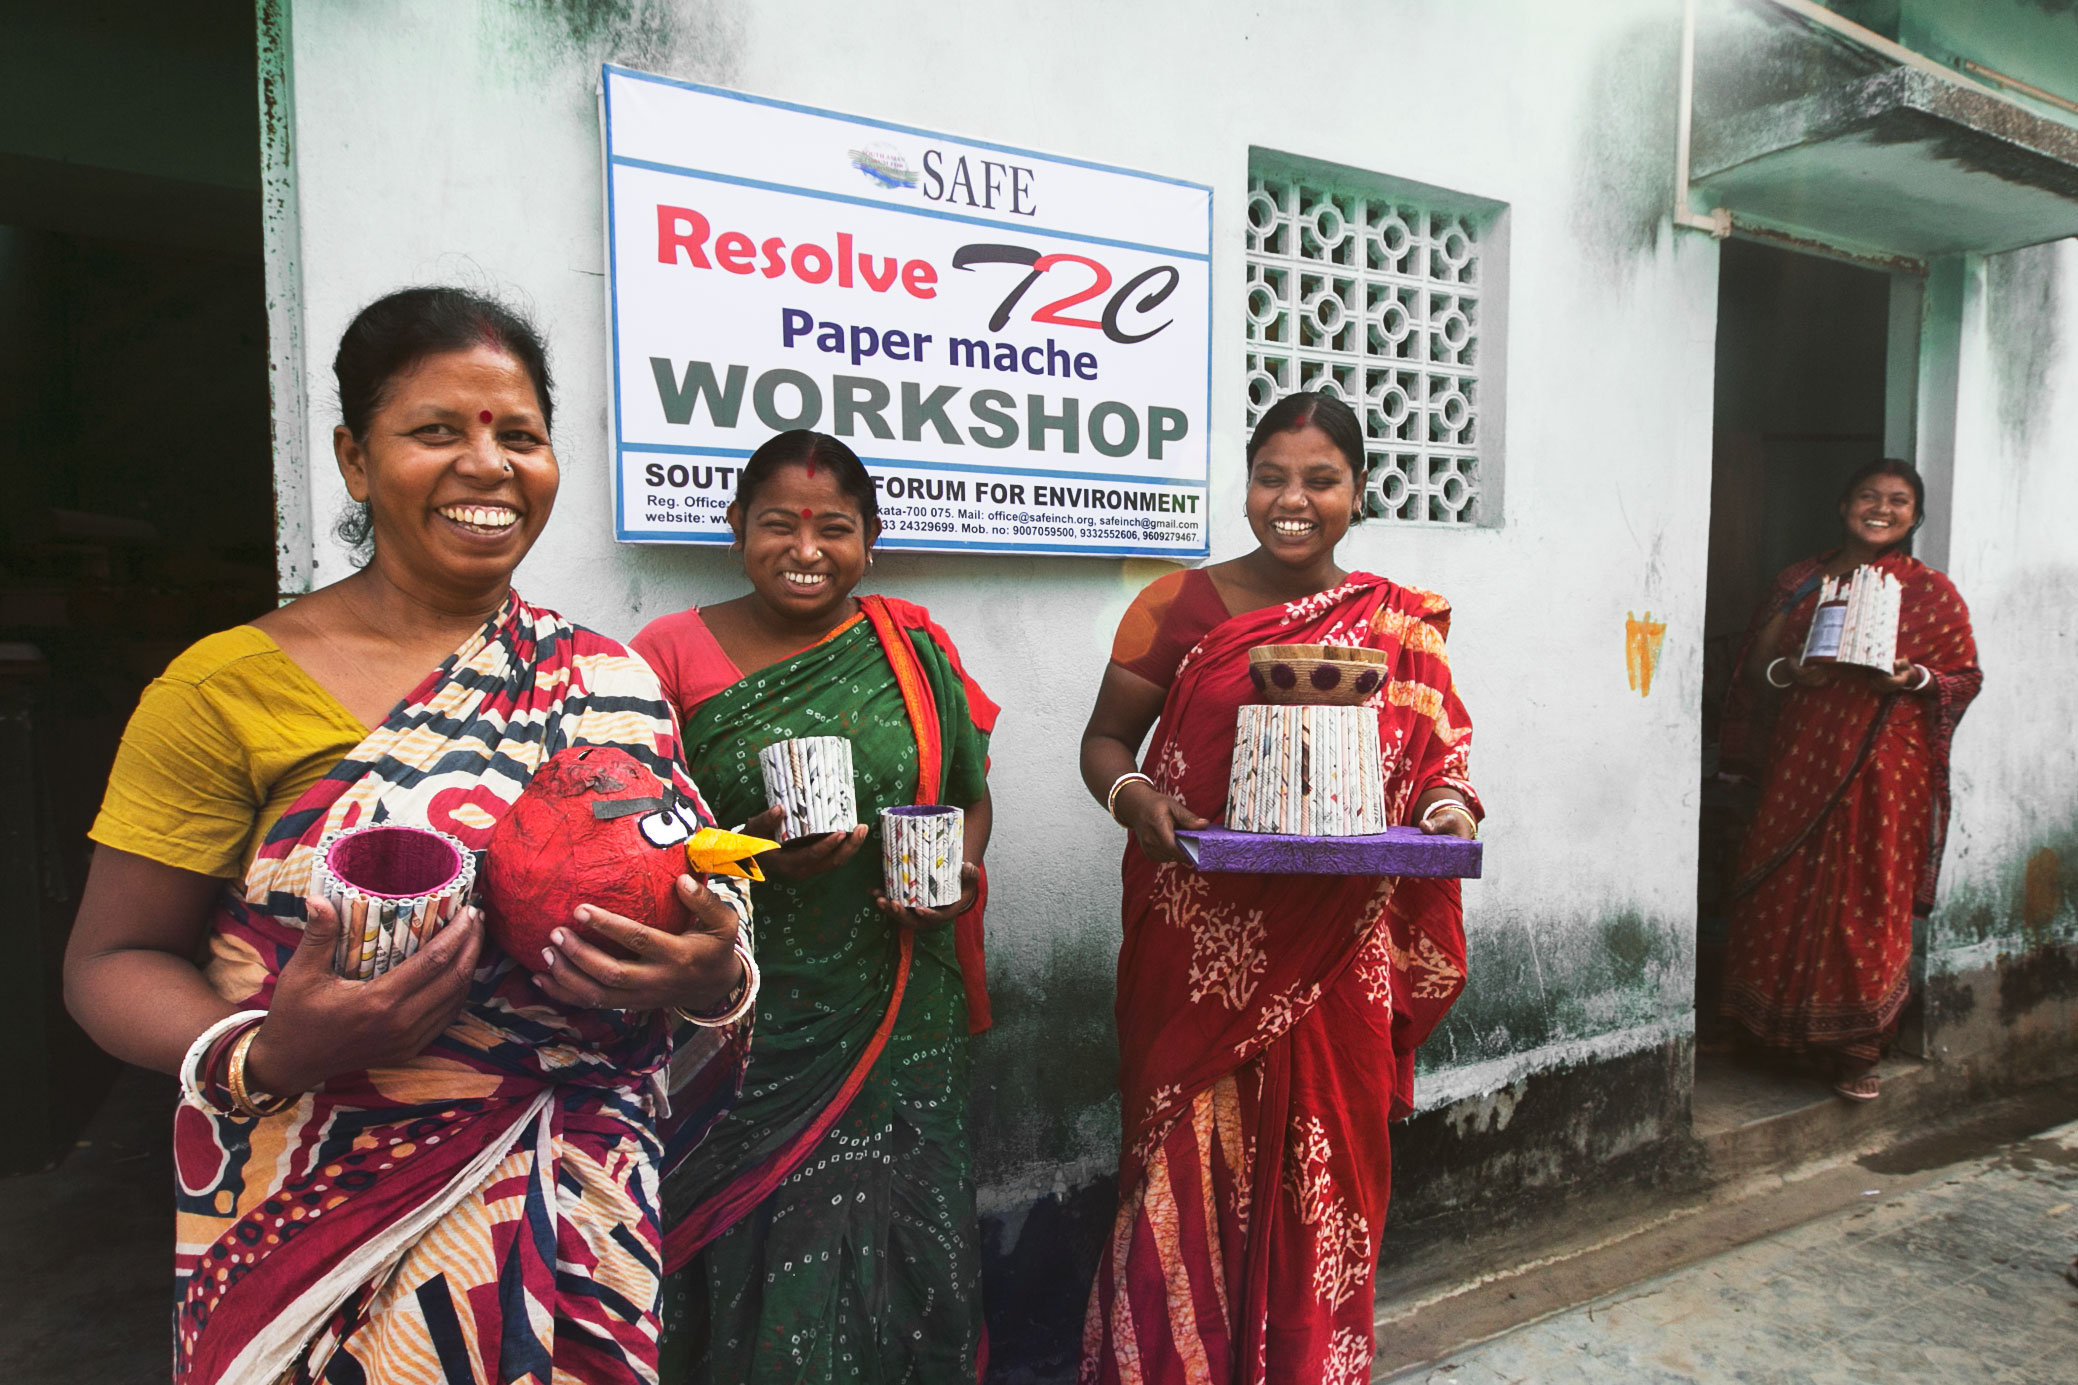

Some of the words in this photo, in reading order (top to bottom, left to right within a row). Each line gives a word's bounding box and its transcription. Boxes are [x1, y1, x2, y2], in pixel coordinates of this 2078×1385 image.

[923, 149, 1037, 216] SAFE
[656, 203, 938, 299] Resolve
[952, 243, 1180, 344] T2C
[782, 307, 932, 366] Paper
[949, 336, 1098, 380] mache
[649, 356, 1189, 460] WORKSHOP
[645, 511, 705, 524] website:
[882, 519, 896, 530] 33
[899, 520, 958, 533] 24329699.
[961, 523, 988, 534] Mob.
[992, 526, 1010, 535] no:
[1012, 525, 1077, 539] 9007059500,
[1080, 528, 1141, 541] 9332552606,
[646, 494, 679, 509] Reg.
[877, 504, 927, 517] kata-700
[930, 507, 955, 518] 075.
[957, 509, 984, 520] Mail:
[987, 511, 1097, 527] office@safeinch.org,
[1099, 516, 1199, 529] safeinch@gmail.com
[870, 475, 966, 502] FORUM
[975, 482, 1026, 505] FOR
[1033, 485, 1200, 514] ENVIRONMENT
